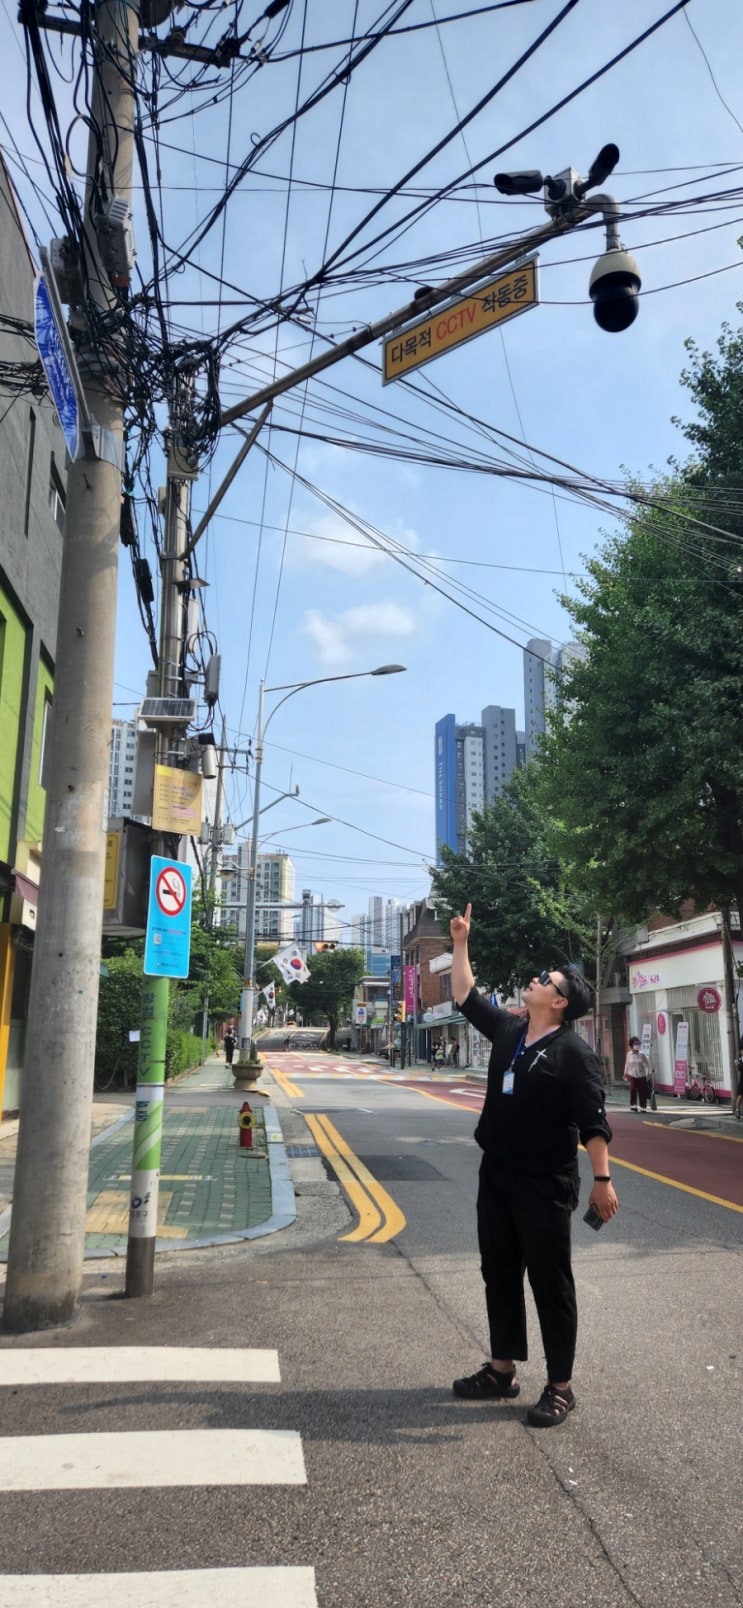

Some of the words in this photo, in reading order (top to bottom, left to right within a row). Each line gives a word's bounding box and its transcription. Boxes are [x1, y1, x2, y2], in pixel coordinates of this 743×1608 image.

[391, 327, 431, 362] 다목적
[436, 303, 477, 340] CCTV
[482, 274, 528, 312] 작동중
[139, 1026, 152, 1076] CCTV
